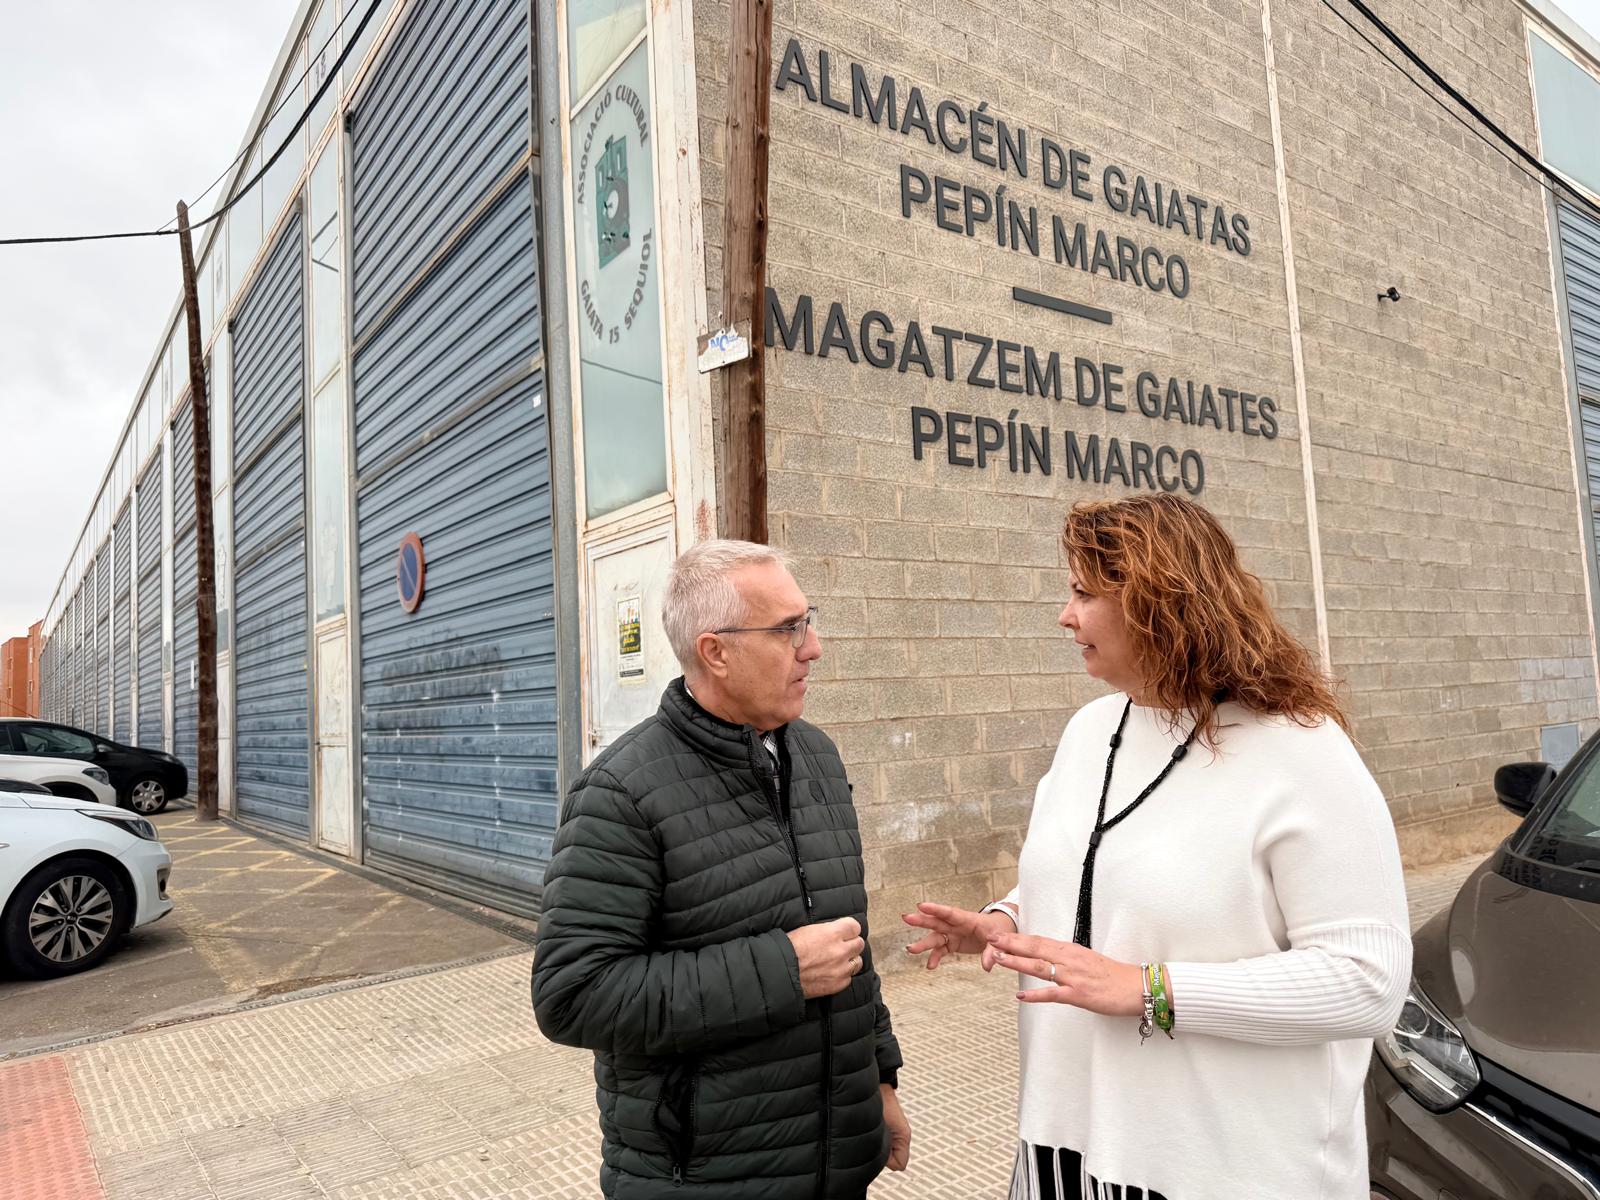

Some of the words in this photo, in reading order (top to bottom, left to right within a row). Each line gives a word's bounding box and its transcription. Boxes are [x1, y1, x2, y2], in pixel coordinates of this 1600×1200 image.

[577, 89, 612, 205] ASSOCIACIÓ
[615, 84, 649, 148] CULTURAL
[775, 37, 1028, 178] ALMACÉN
[1042, 137, 1093, 201] DE
[1104, 165, 1252, 256] GAIATAS
[580, 279, 604, 341] GAIATA
[609, 325, 620, 344] 15
[624, 228, 652, 331] SEQUIOL
[900, 163, 1040, 256] PEPÍN
[1052, 214, 1190, 298] MARCO
[764, 286, 1062, 401] MAGATZEM
[1075, 356, 1127, 413] DE
[1136, 371, 1279, 440] GAIATES
[911, 406, 1051, 476] PEPÍN
[1065, 430, 1204, 495] MARCO
